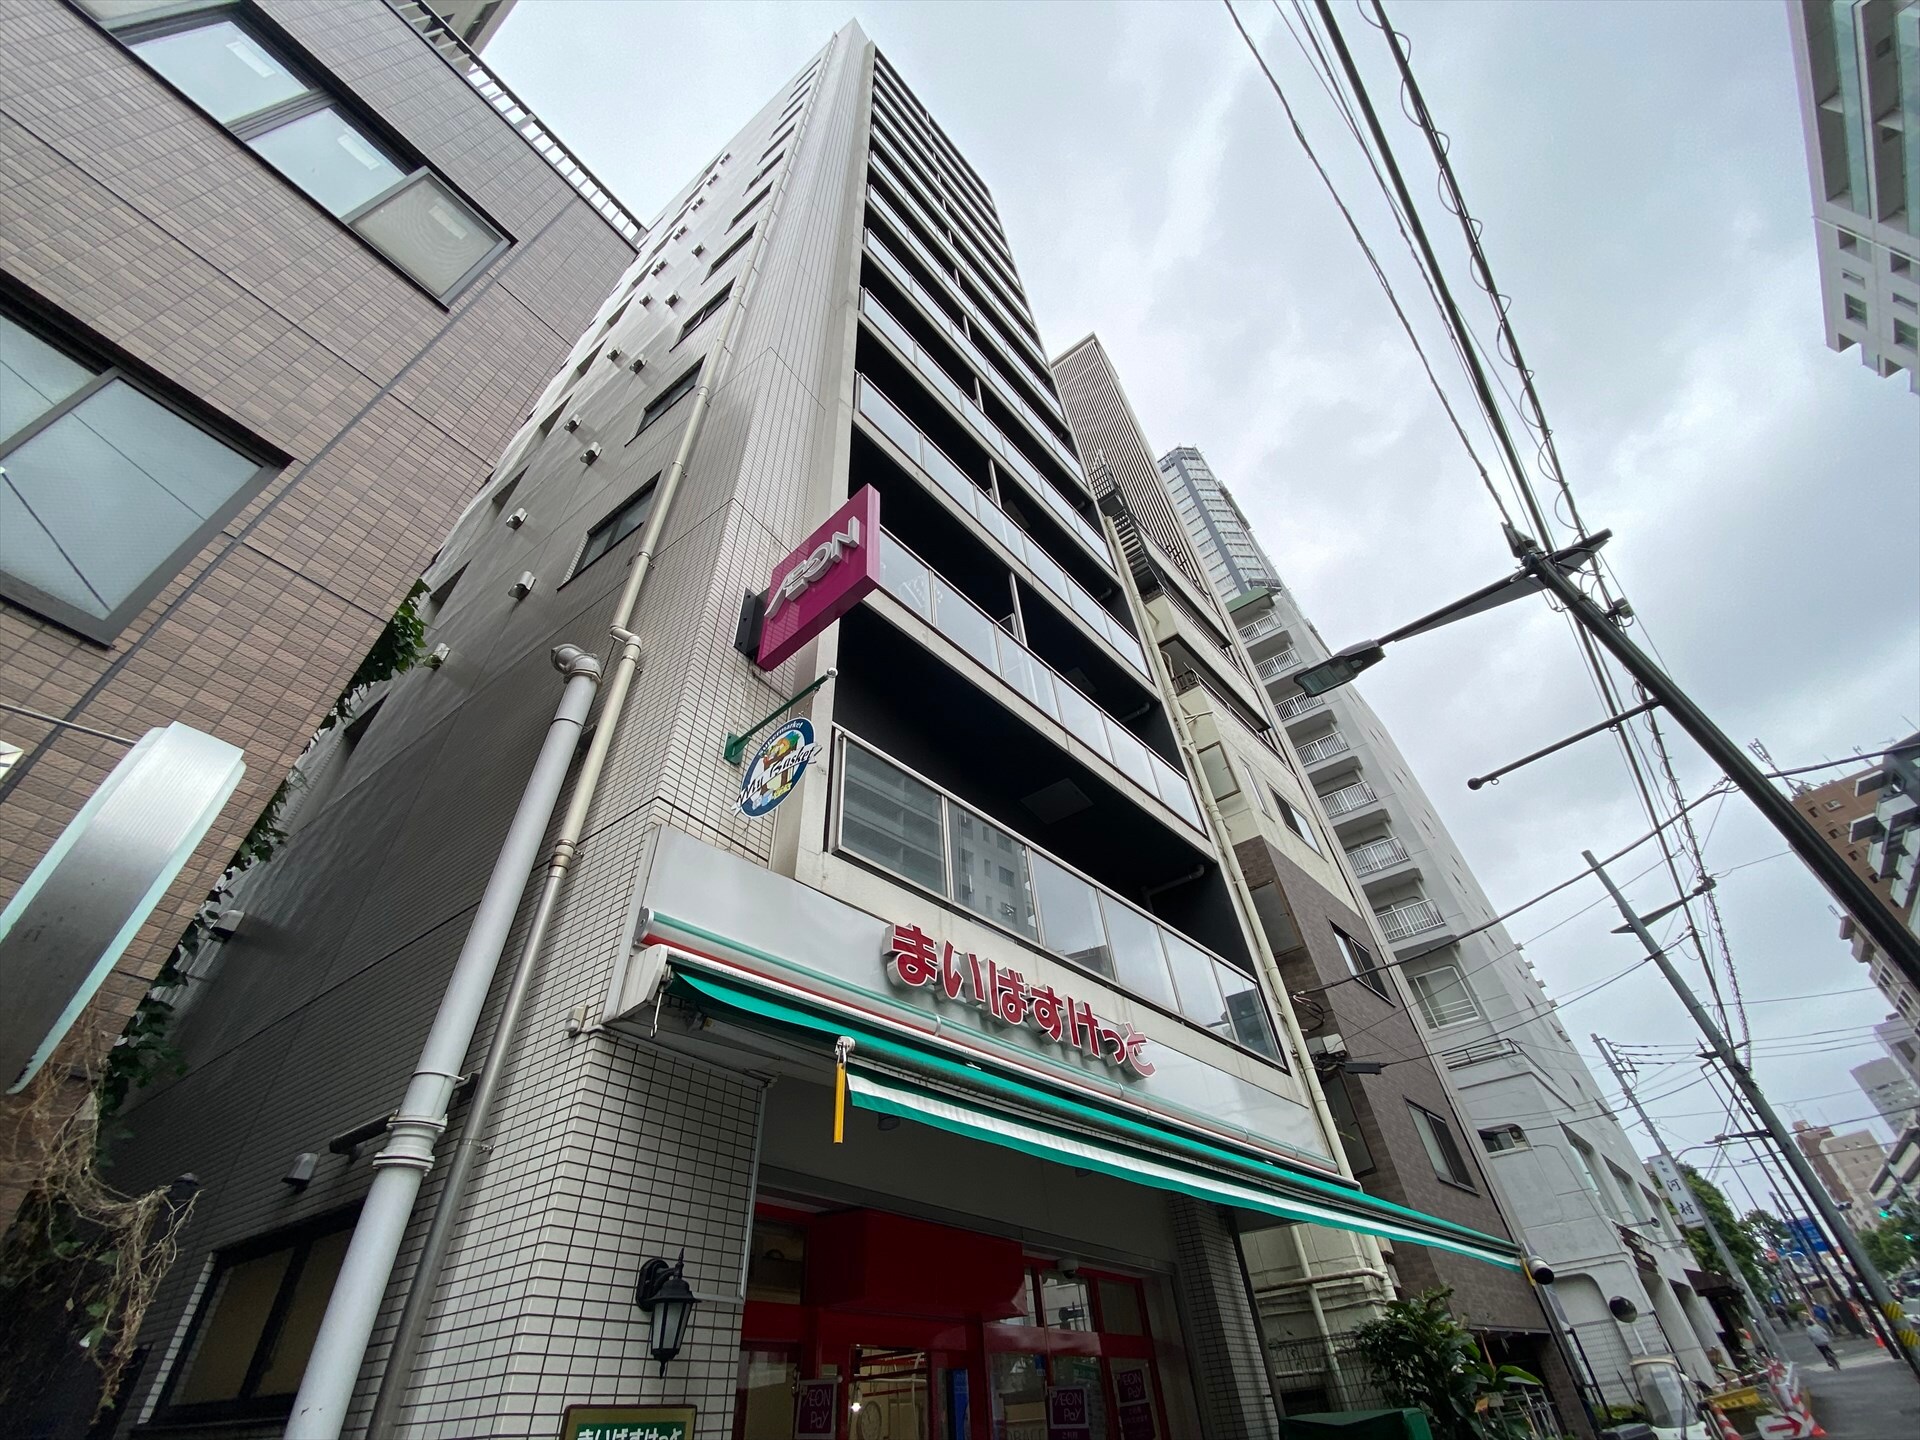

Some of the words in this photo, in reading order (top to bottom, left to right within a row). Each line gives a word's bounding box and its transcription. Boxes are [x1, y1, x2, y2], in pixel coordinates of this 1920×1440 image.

[736, 775, 765, 805] My
[769, 746, 816, 778] Basket
[884, 923, 1156, 1079] まいばすけっと
